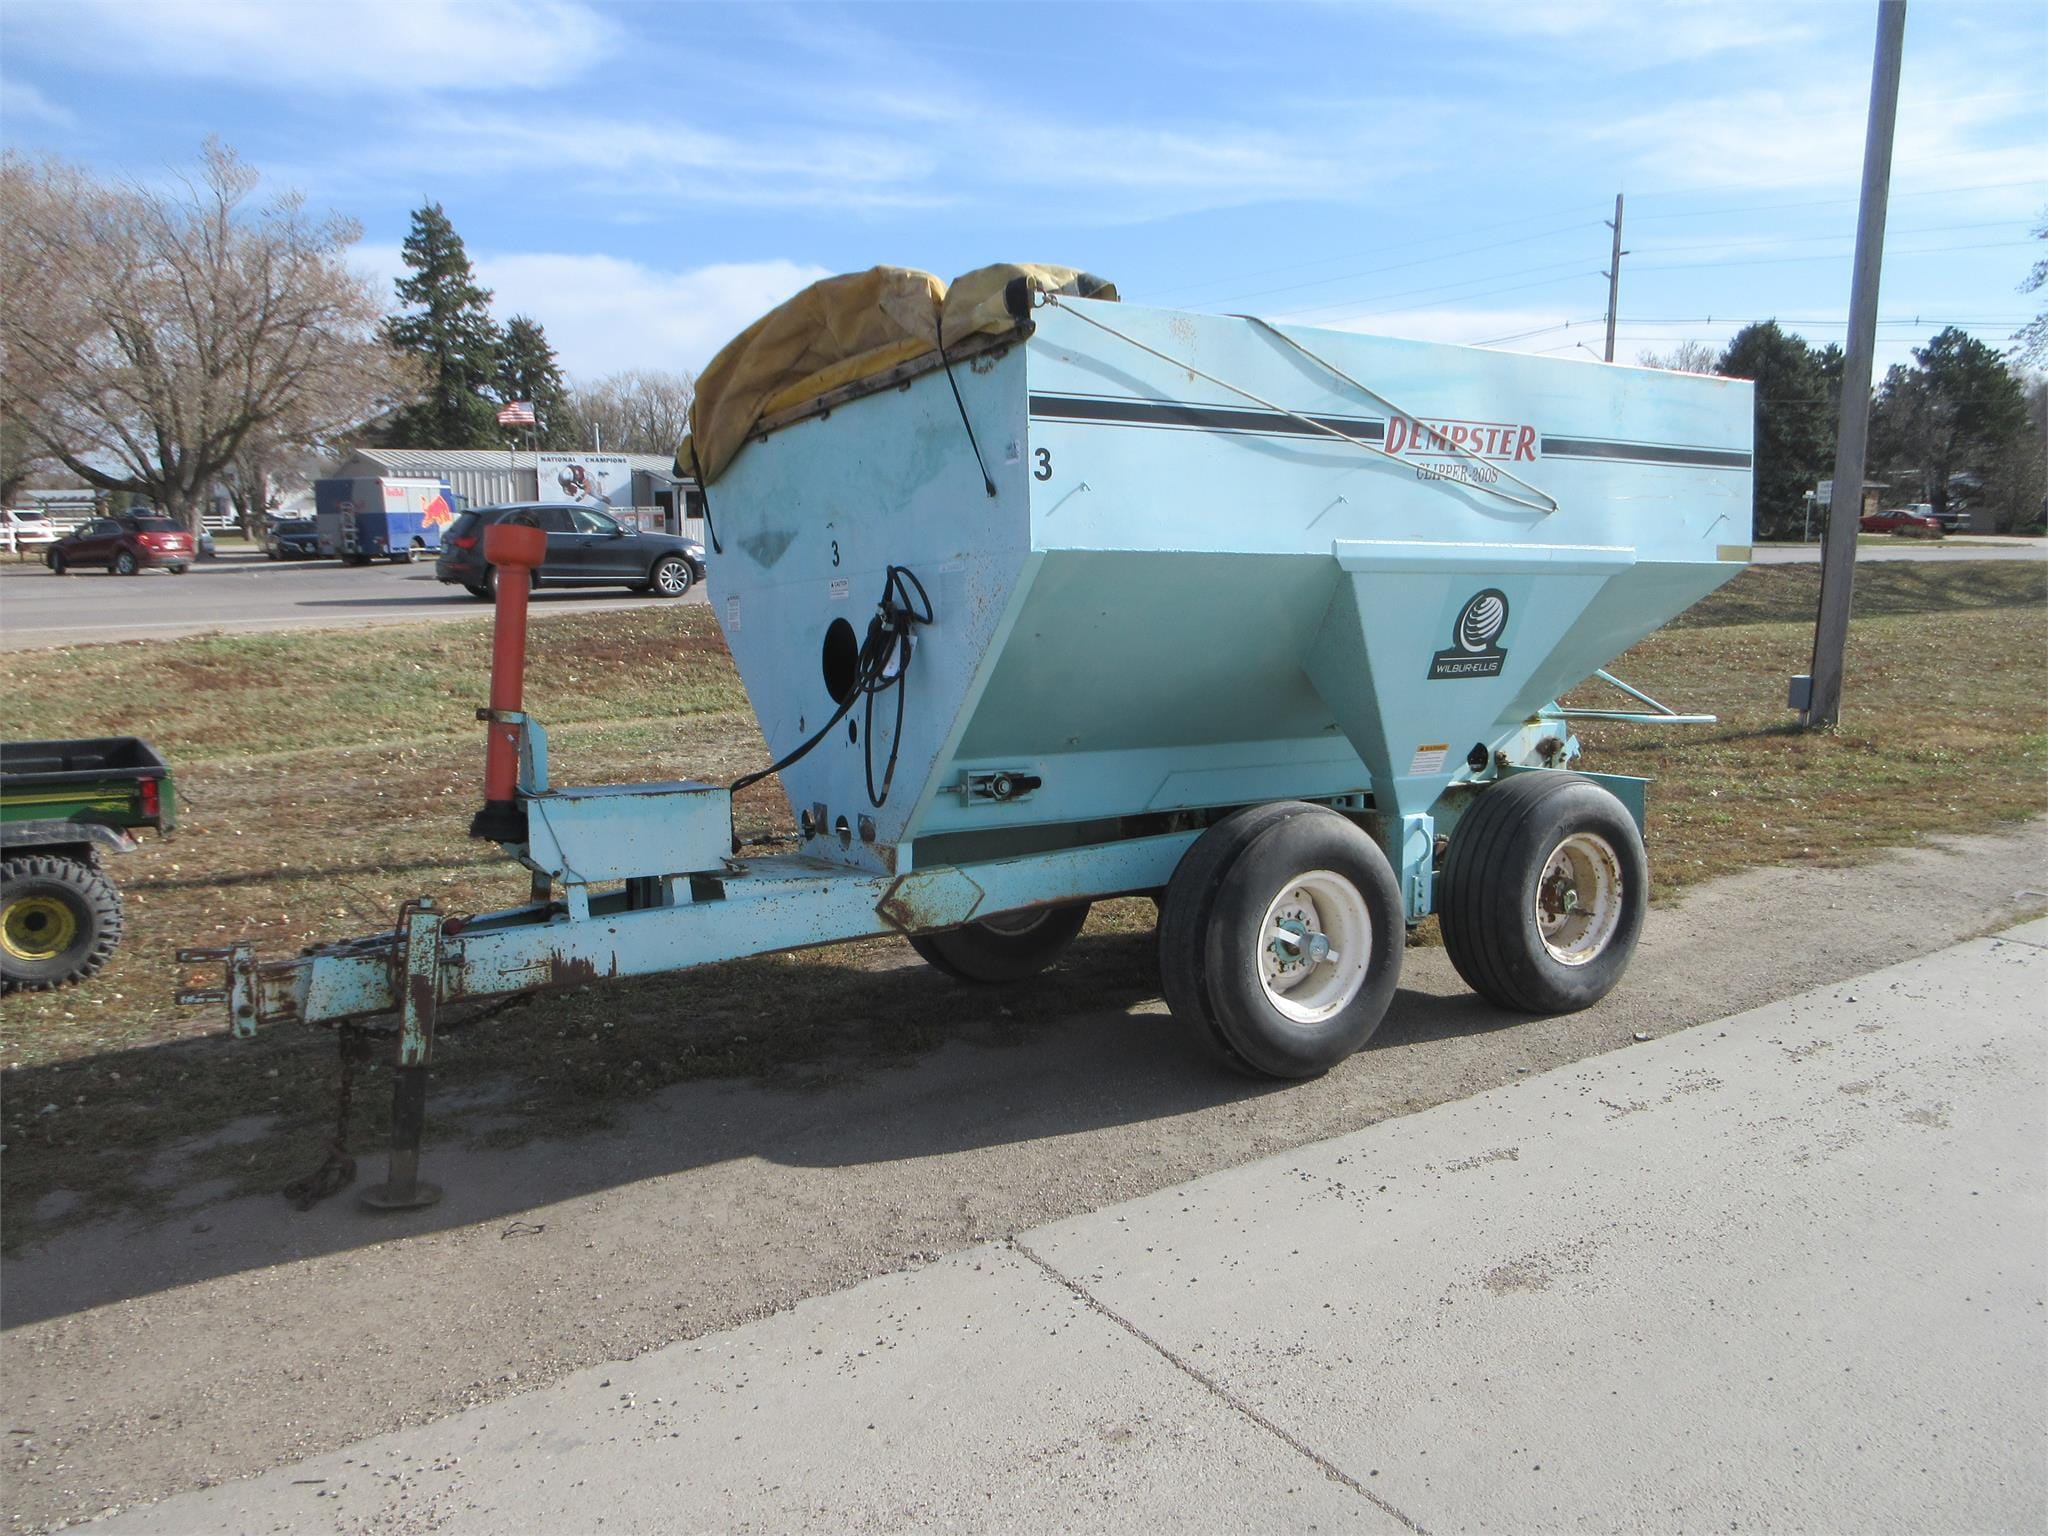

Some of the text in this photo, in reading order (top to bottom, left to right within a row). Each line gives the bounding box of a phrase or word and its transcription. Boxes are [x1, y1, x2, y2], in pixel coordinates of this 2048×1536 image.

[1384, 416, 1536, 462] DEMPSTER
[1034, 448, 1052, 481] 3
[831, 540, 840, 567] 3
[1436, 662, 1498, 673] WILBUR-ELLIS
